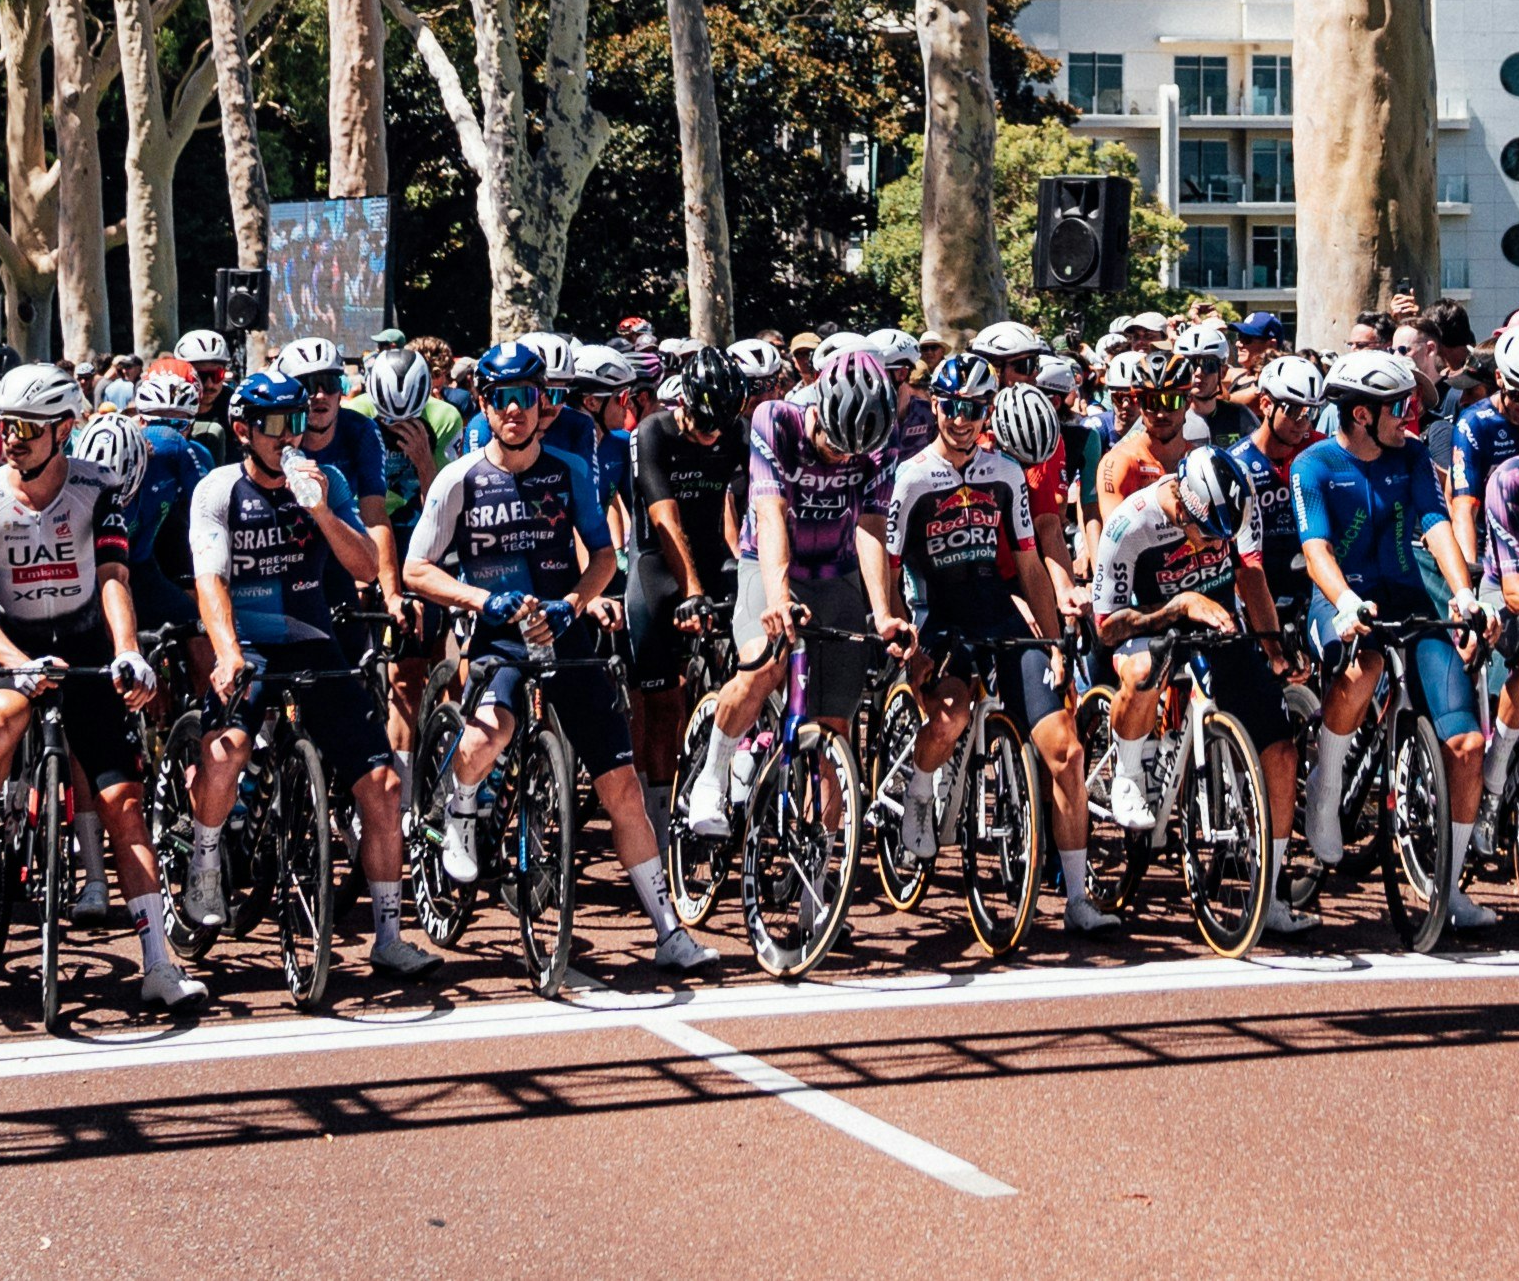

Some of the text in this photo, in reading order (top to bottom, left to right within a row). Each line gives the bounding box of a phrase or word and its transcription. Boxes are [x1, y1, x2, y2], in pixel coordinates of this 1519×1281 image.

[671, 471, 702, 481] Euro
[677, 480, 723, 490] ycling
[784, 466, 863, 492] Jayco
[1105, 459, 1115, 494] BMC
[465, 500, 531, 528] ISRAEL
[788, 507, 852, 520] ALULA
[1020, 483, 1031, 528] BOSS
[1292, 472, 1309, 533] SHIMANO
[927, 509, 1001, 537] Red Bull
[1336, 507, 1368, 564] CACHE
[501, 530, 555, 544] PREMIER
[502, 541, 536, 552] TECH
[927, 527, 998, 556] BORA
[9, 542, 75, 567] UAE
[258, 553, 304, 566] PREMIER
[1156, 538, 1230, 583] Red Bull
[19, 567, 73, 581] Emirates
[260, 564, 288, 576] TECH
[1159, 556, 1233, 595] BORA
[14, 585, 82, 601] XRG
[1114, 562, 1129, 605] BOSS
